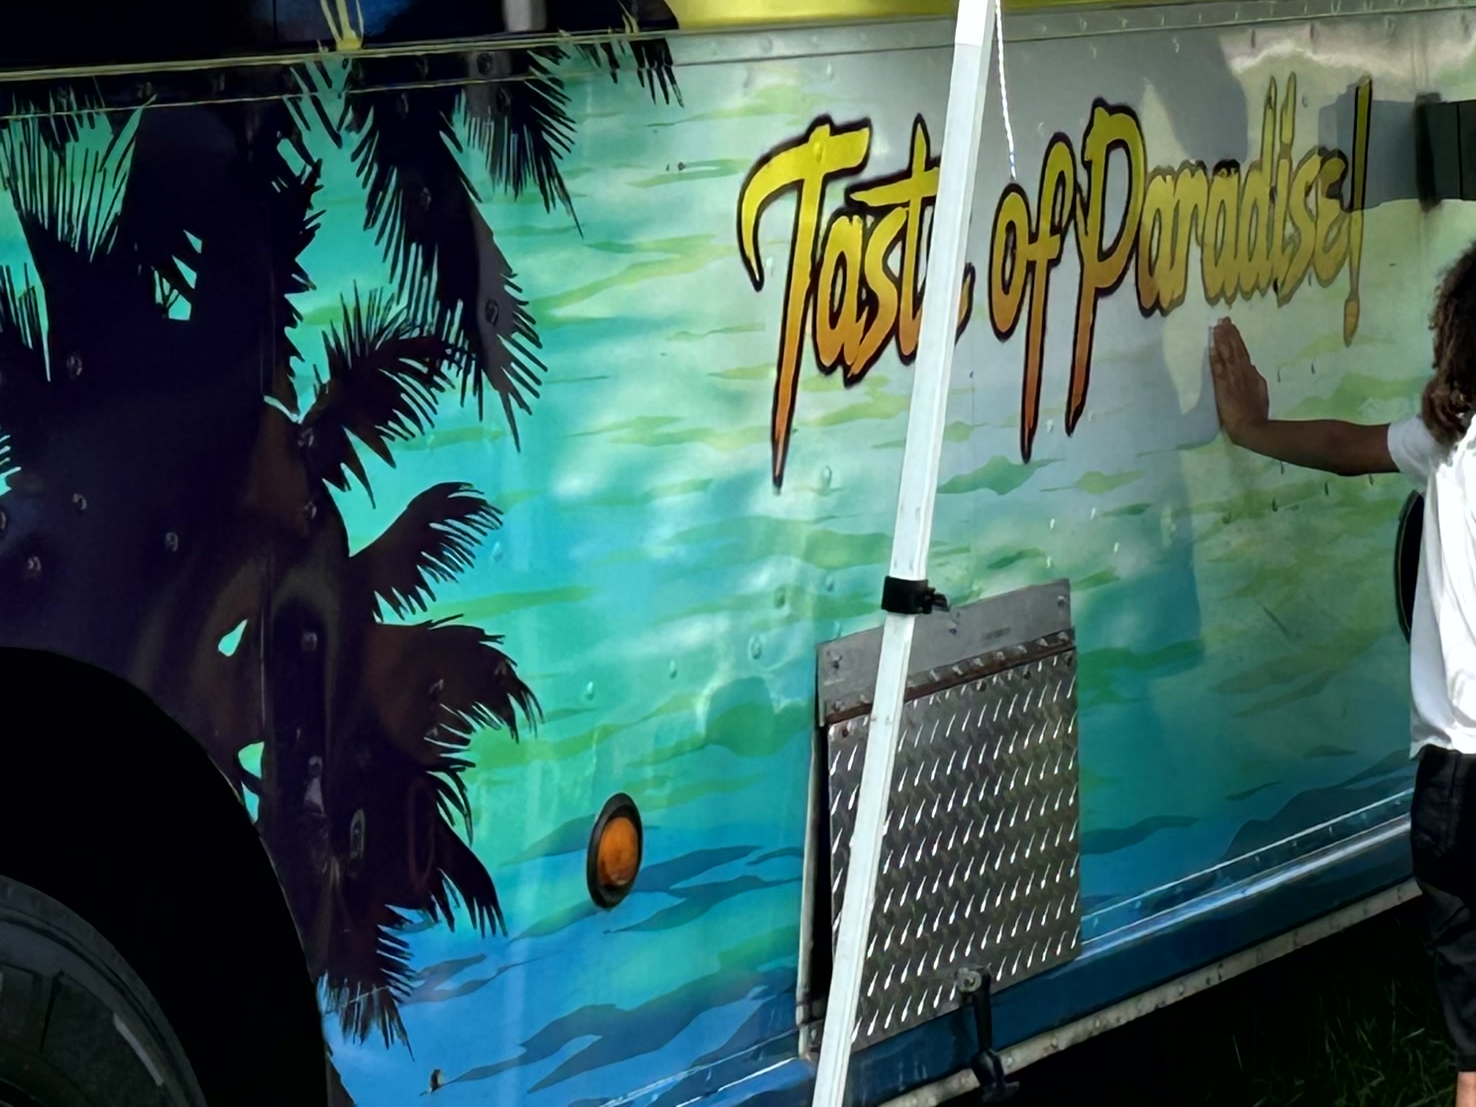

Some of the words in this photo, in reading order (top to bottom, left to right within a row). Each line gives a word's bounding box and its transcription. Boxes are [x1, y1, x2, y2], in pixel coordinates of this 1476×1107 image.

[738, 113, 975, 495] Tast
[988, 131, 1076, 464] of
[1064, 71, 1373, 437] Paradise!
